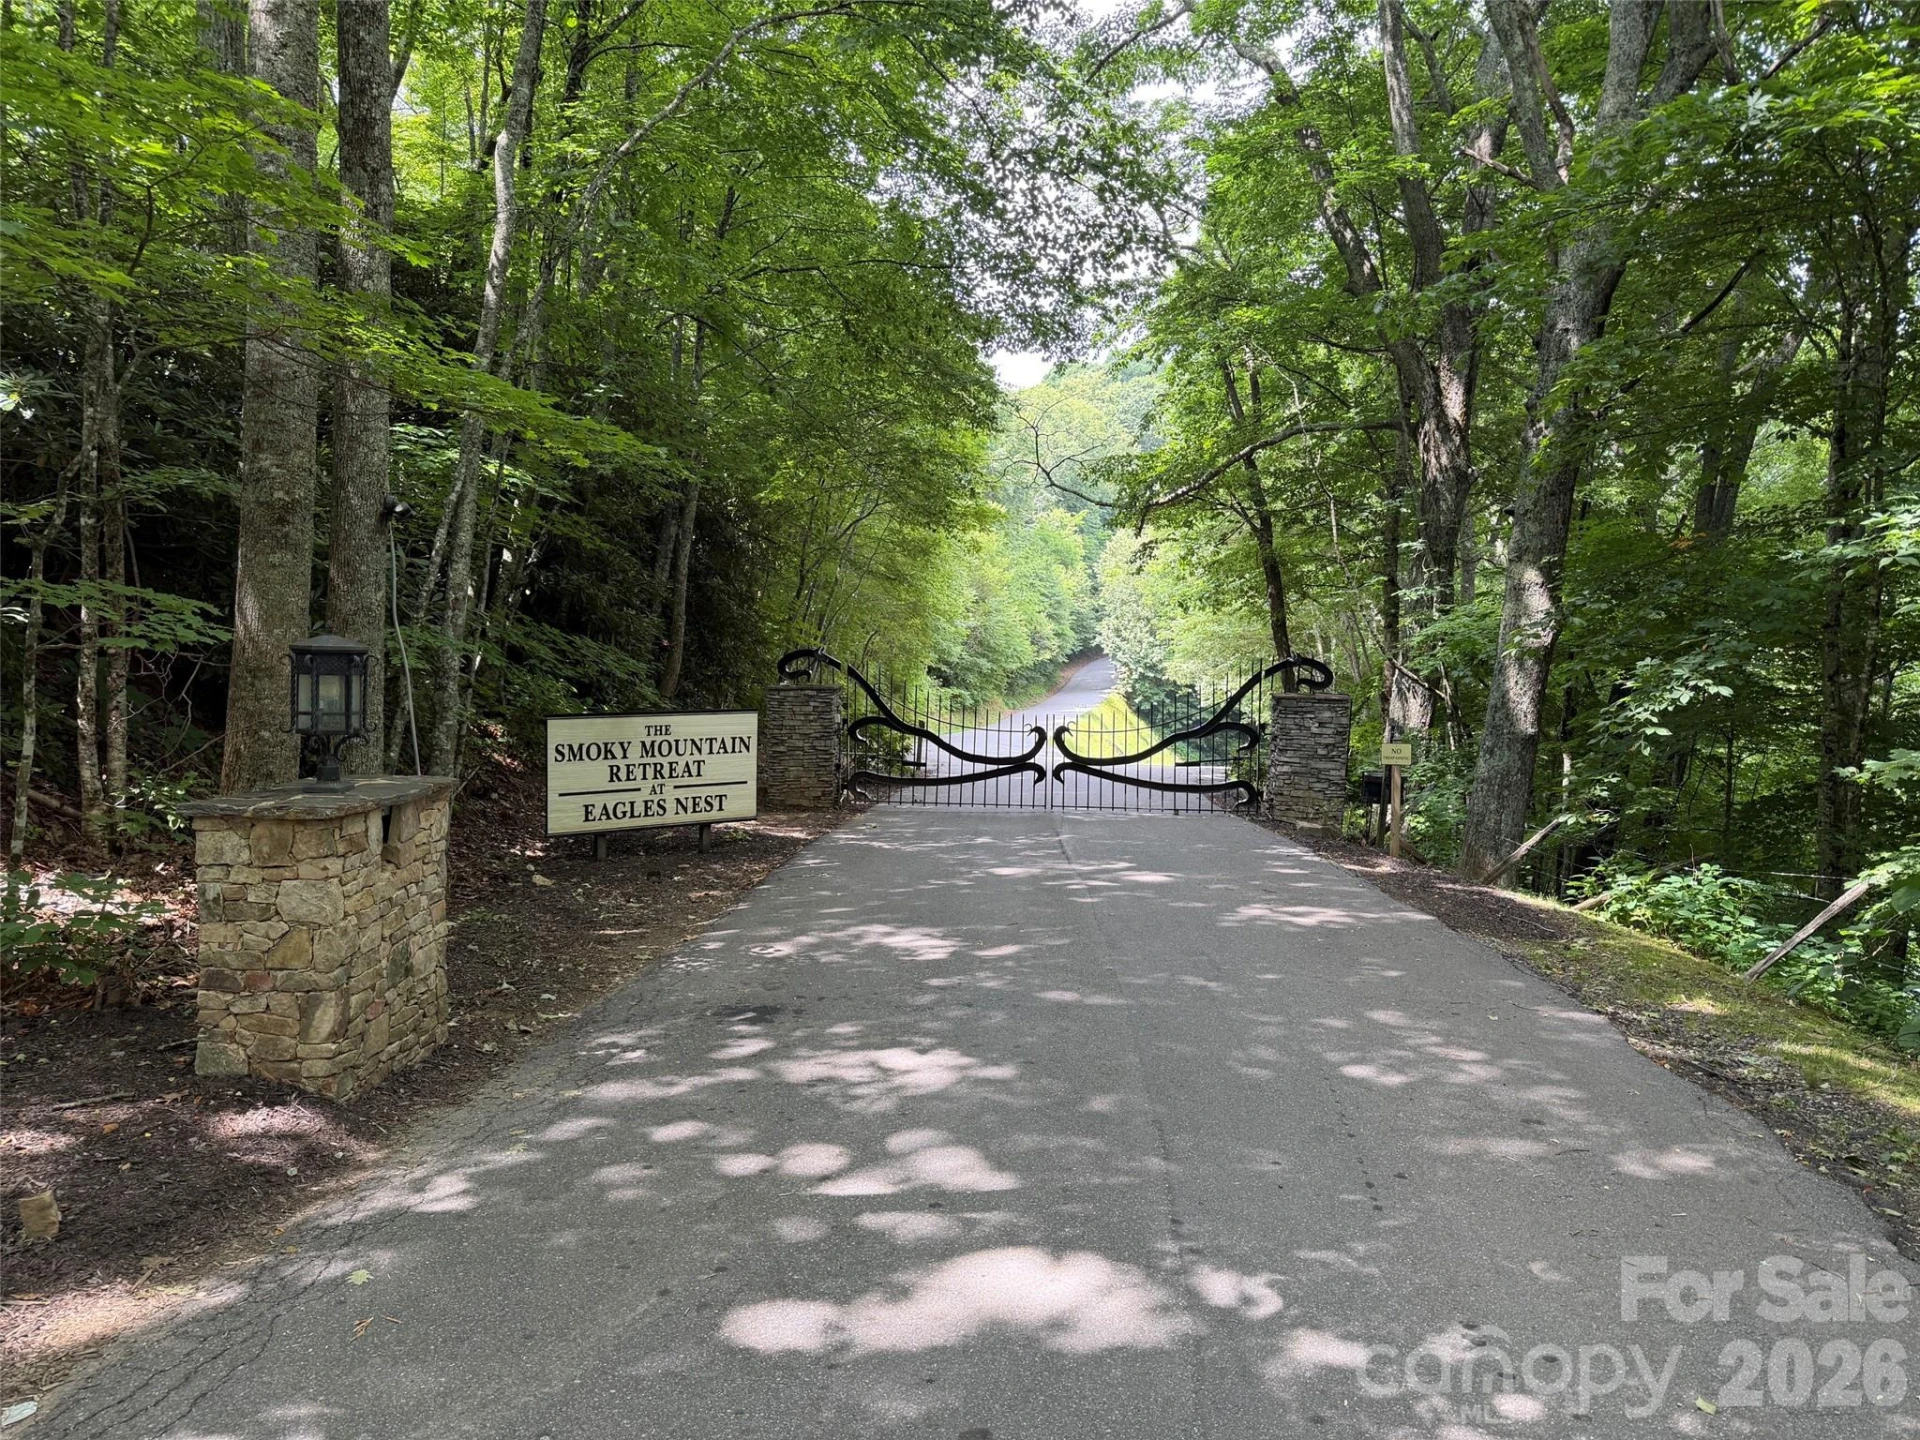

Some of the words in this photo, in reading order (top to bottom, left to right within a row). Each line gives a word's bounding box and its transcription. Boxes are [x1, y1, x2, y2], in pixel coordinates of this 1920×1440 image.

[645, 725, 671, 736] THE
[554, 741, 632, 762] SMOKY
[639, 736, 752, 759] MOUNTAIN
[608, 760, 706, 783] RETREAT
[649, 784, 666, 795] AT
[583, 799, 667, 822] EAGLES
[674, 794, 728, 815] NEST
